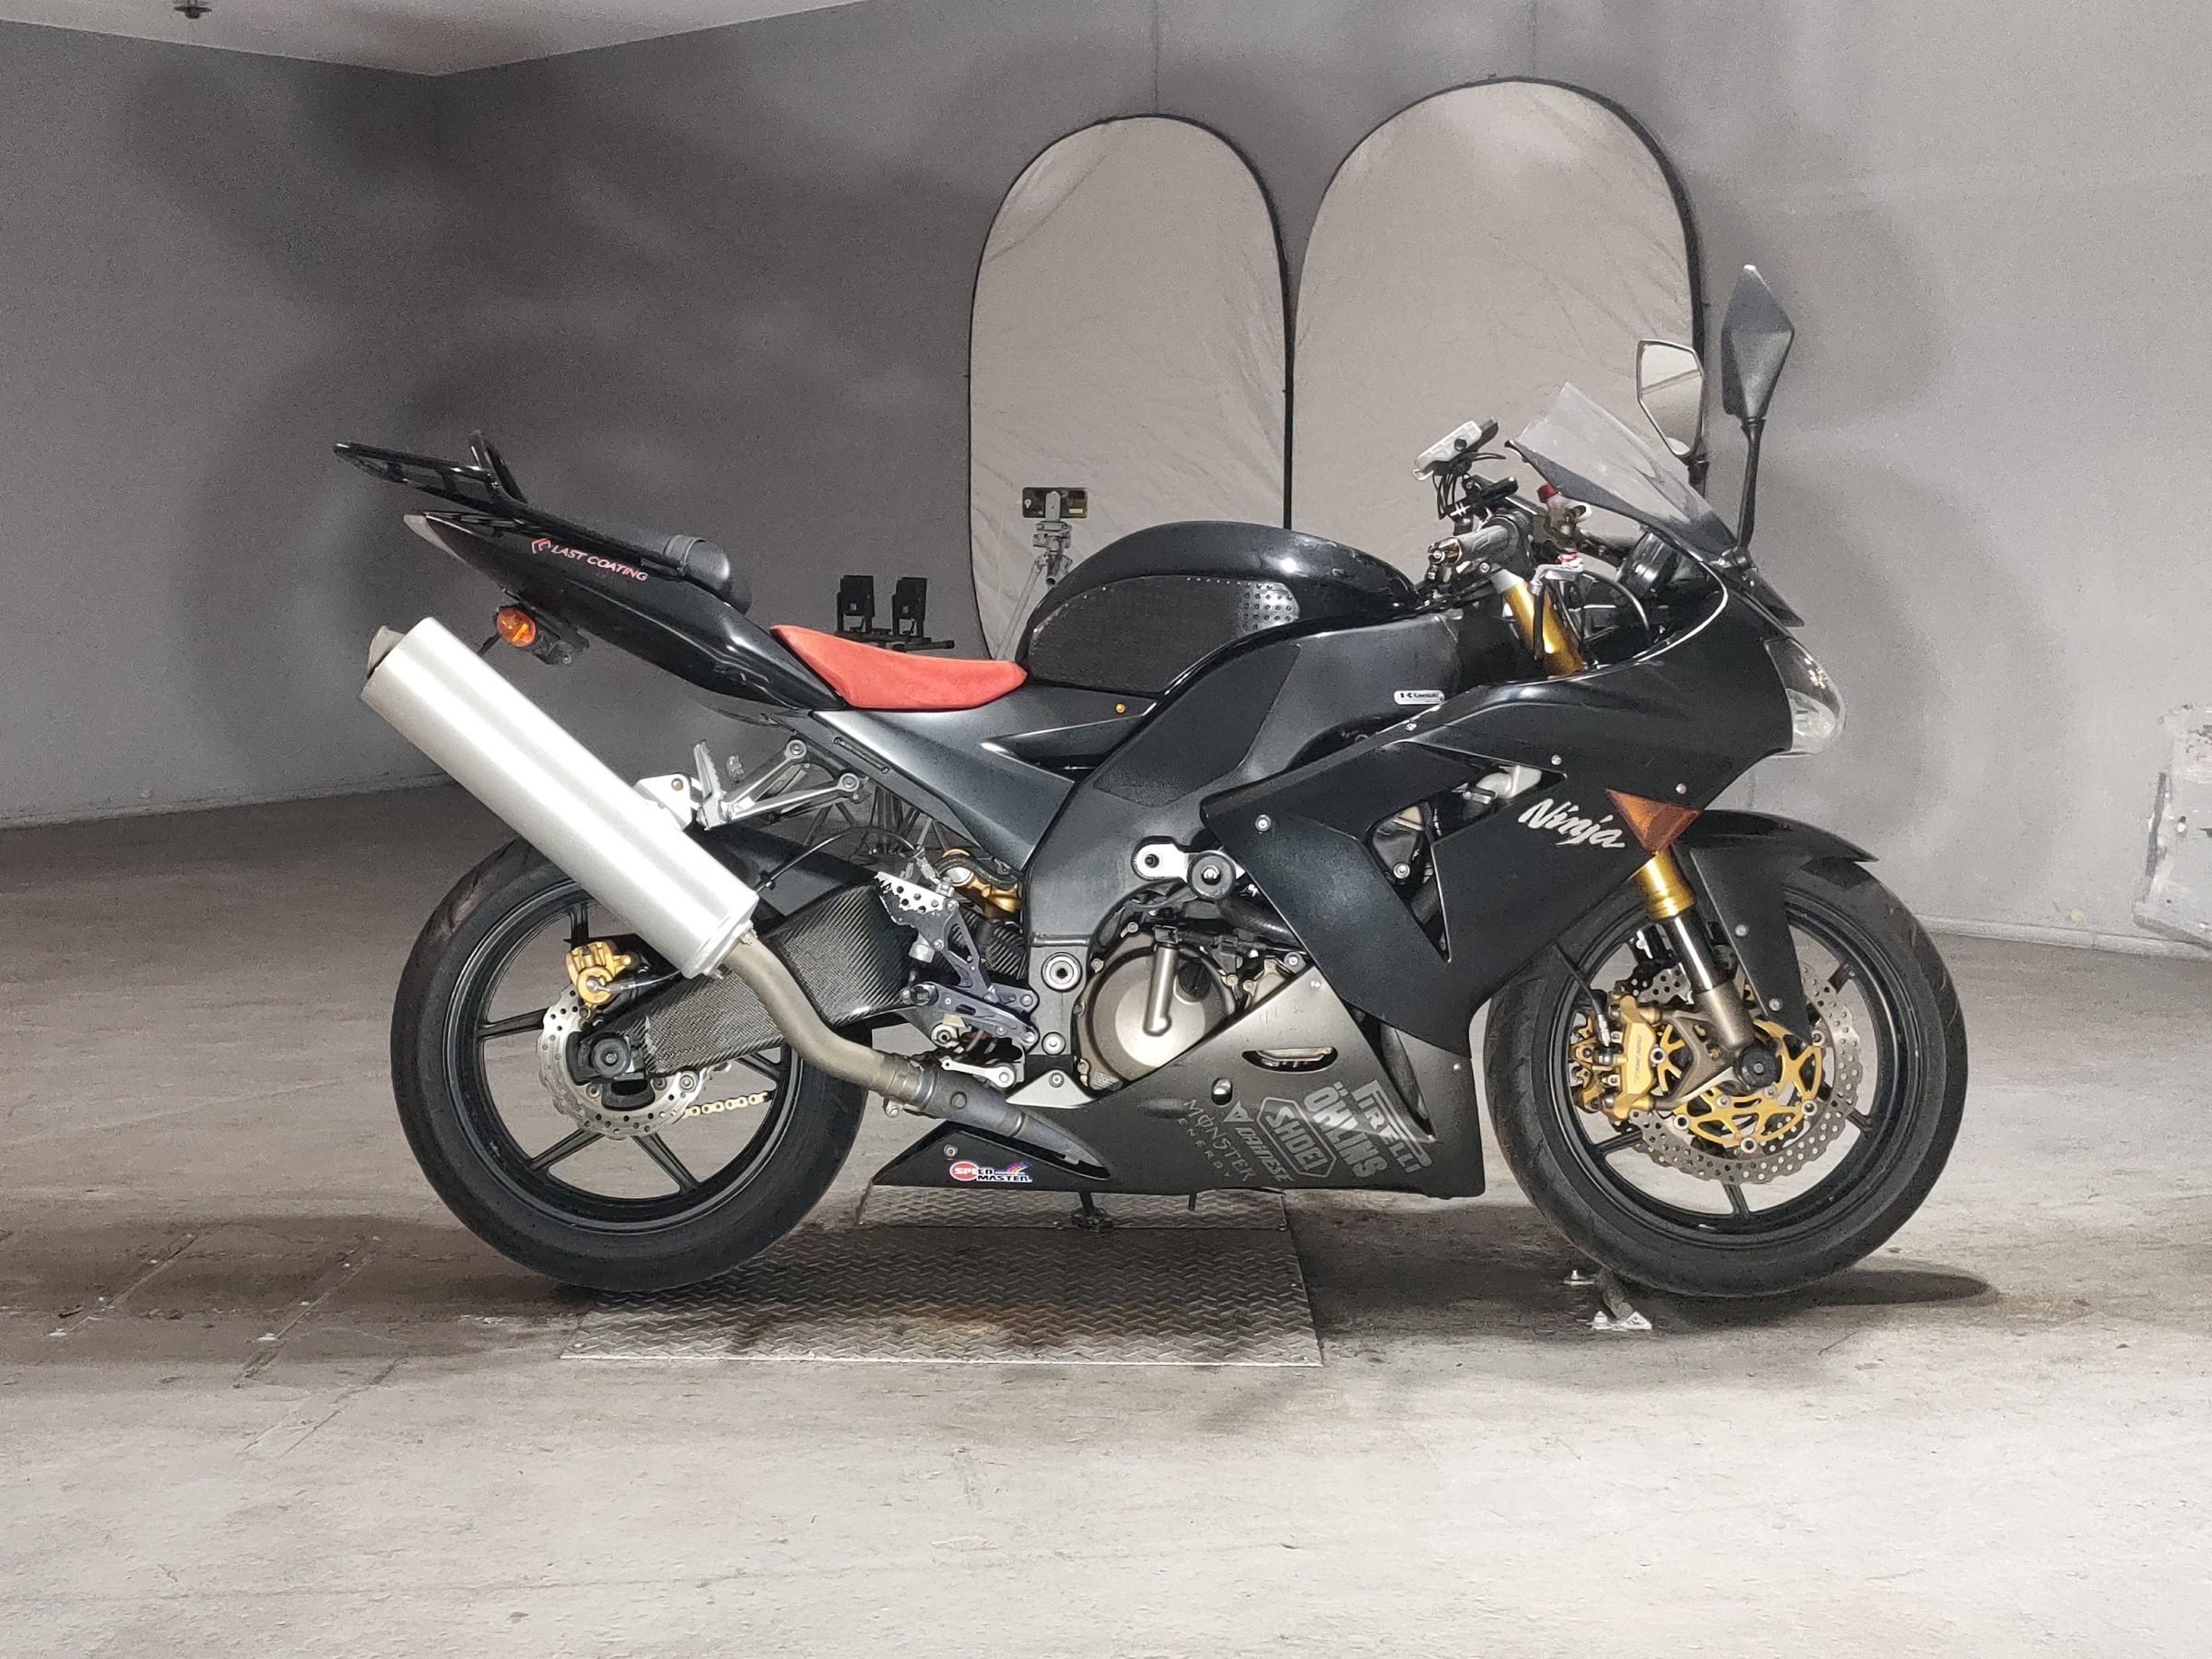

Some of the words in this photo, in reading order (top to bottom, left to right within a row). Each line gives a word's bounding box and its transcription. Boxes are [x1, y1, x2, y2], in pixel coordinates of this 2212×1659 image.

[551, 545, 588, 560] LAST
[587, 556, 649, 581] COATING
[1518, 798, 1626, 848] Ninja
[1265, 1106, 1328, 1171] SHOEI
[1303, 1081, 1388, 1178] ÖHLINS
[1350, 1079, 1432, 1173] PIRELLI
[954, 1167, 993, 1175] SPEED
